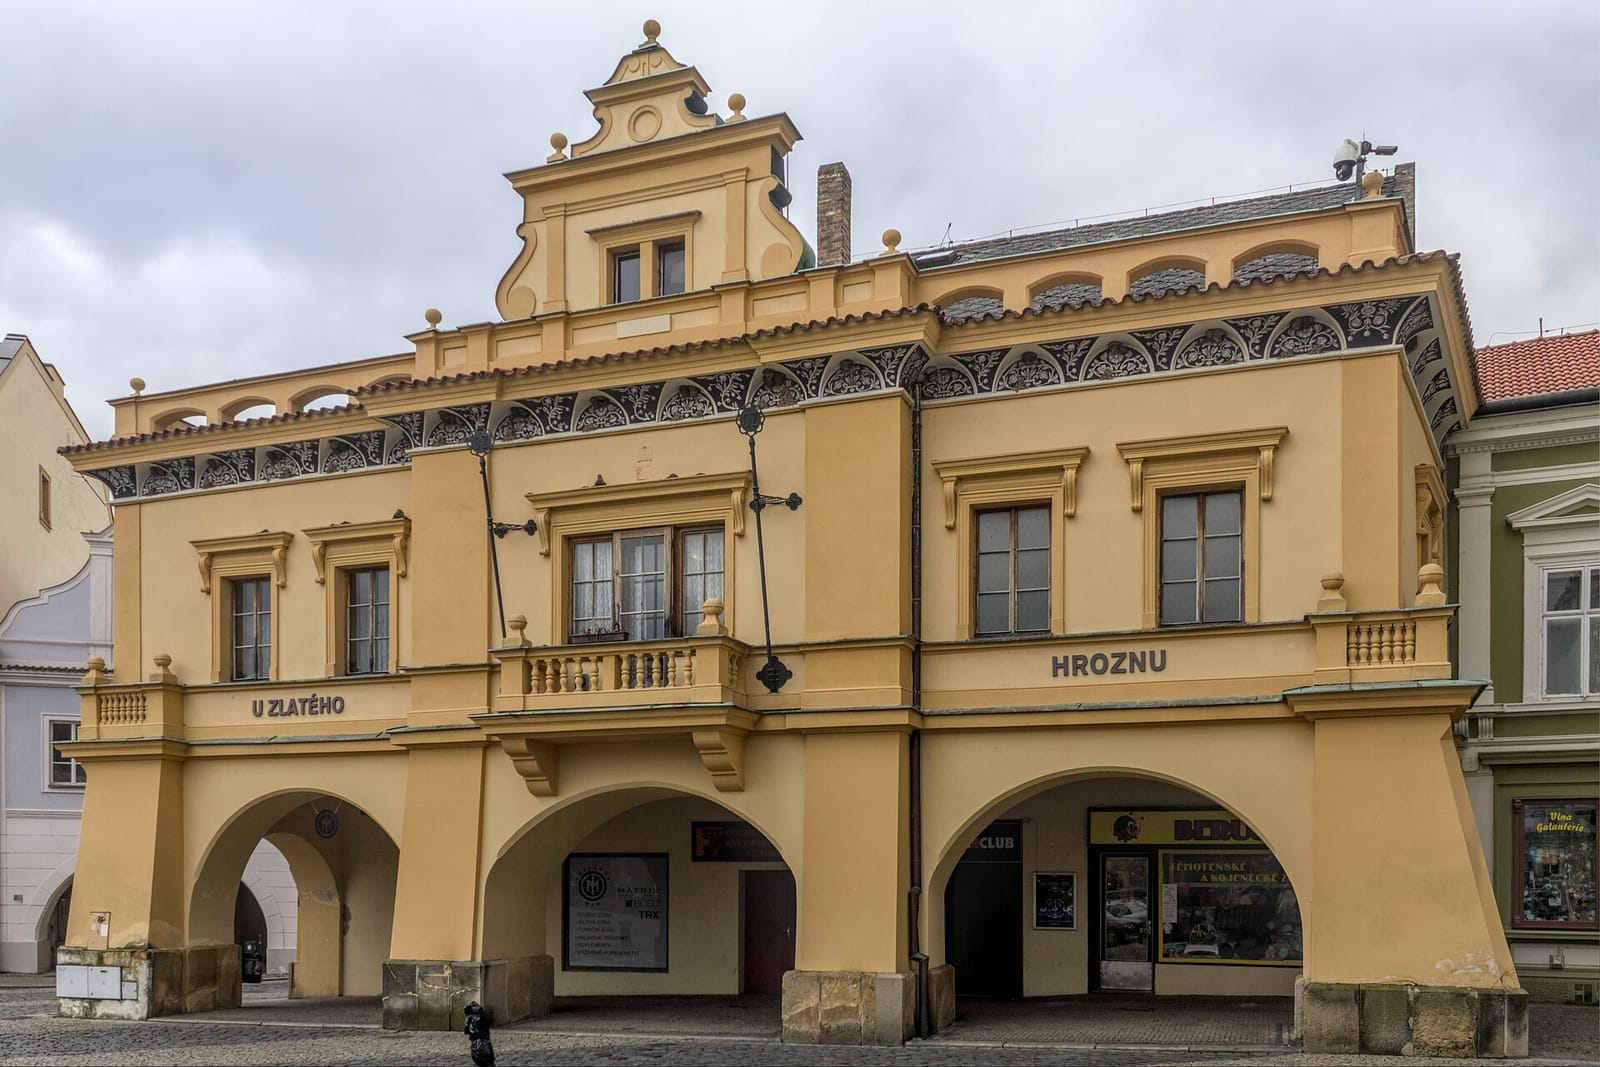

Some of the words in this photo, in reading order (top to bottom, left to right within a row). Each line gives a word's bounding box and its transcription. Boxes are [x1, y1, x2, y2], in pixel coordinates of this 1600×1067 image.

[1052, 649, 1167, 678] HROZNU
[252, 700, 264, 718] U
[267, 693, 345, 717] ZLATÉHO
[1536, 822, 1584, 833] Galanterie
[979, 837, 1015, 849] CLUB
[638, 910, 659, 919] TRX
